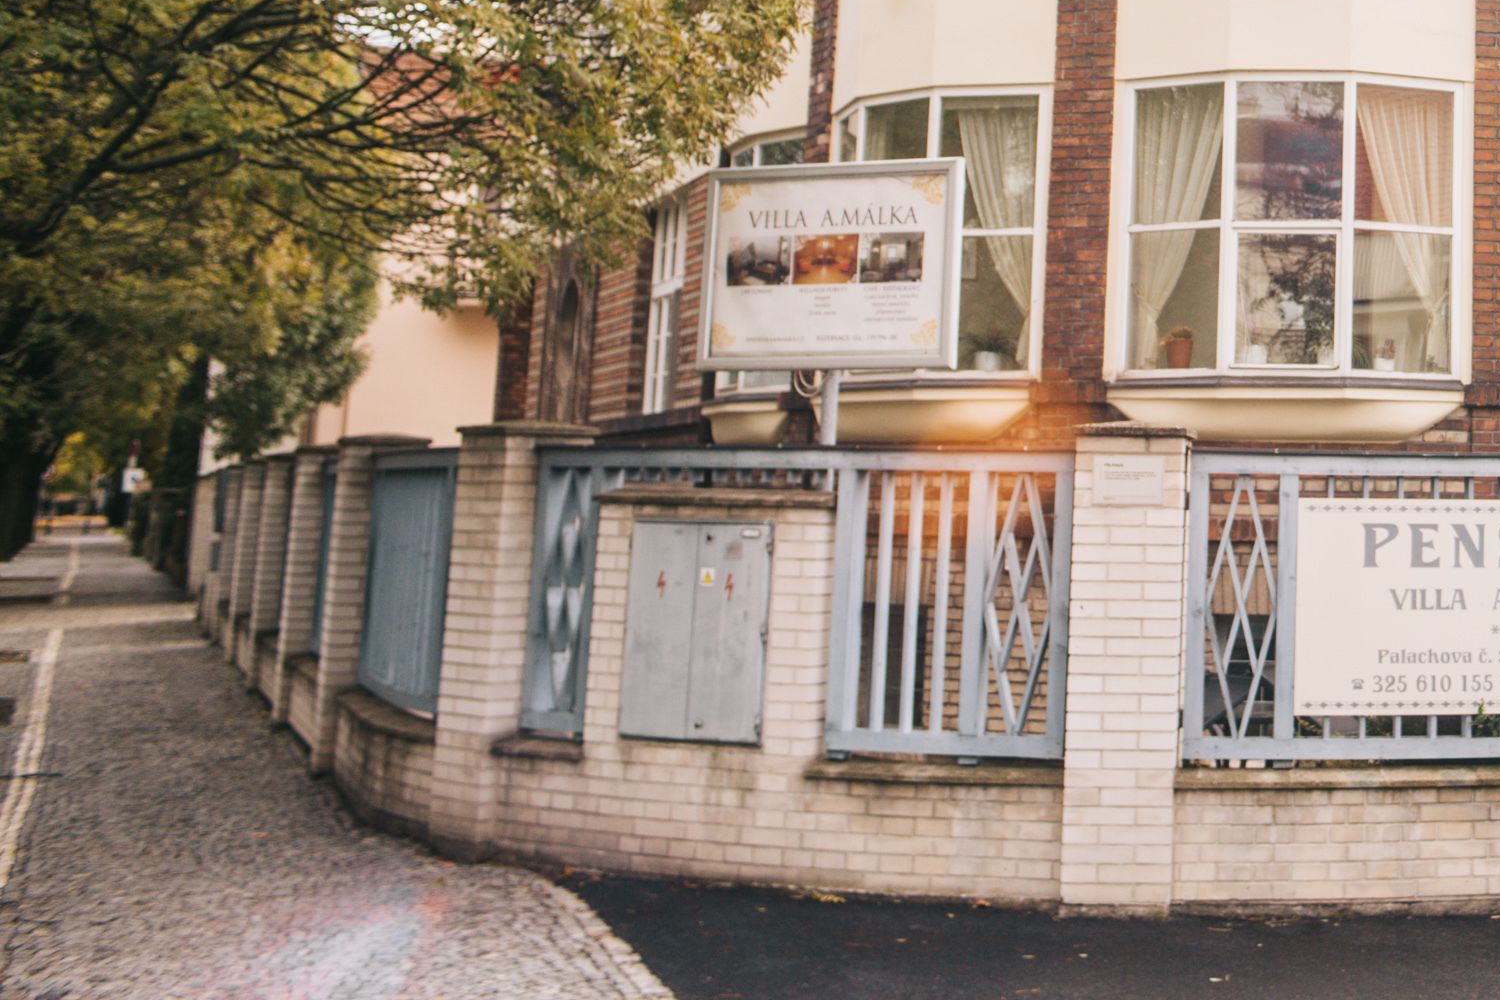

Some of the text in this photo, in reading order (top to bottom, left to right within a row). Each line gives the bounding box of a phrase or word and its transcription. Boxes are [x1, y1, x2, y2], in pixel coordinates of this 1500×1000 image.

[749, 209, 807, 230] VILLA
[1389, 588, 1468, 611] VILLA
[1377, 646, 1473, 664] Palachova
[1478, 647, 1493, 664] č.
[1372, 673, 1408, 693] 325
[1415, 673, 1452, 693] 610
[1461, 673, 1494, 692] 155
